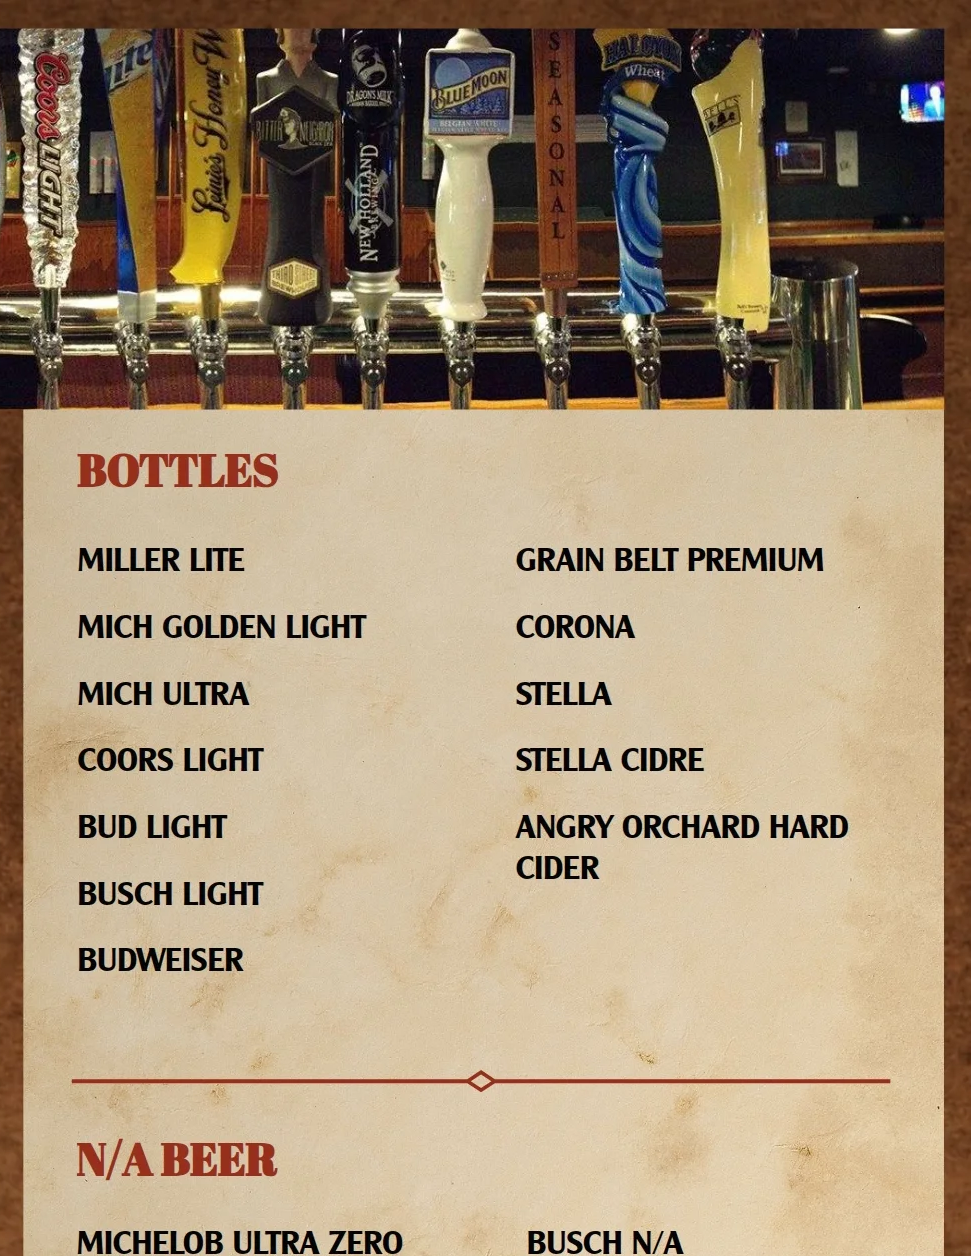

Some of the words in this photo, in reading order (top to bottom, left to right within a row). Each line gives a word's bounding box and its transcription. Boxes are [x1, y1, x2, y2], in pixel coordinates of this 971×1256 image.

[624, 63, 666, 82] Wheat
[34, 52, 70, 142] Coors
[431, 84, 470, 112] BLUE
[471, 69, 508, 96] MOON
[188, 66, 230, 151] Honey
[547, 31, 565, 240] SEASONAL
[37, 141, 64, 238] LIGHT
[359, 144, 379, 220] HOLLAND
[360, 225, 378, 261] NEW
[77, 453, 278, 487] BOTTLES
[78, 548, 180, 571] MILLER
[191, 548, 245, 571] LITE
[516, 548, 603, 571] GRAIN
[615, 548, 679, 571] BELT
[688, 548, 823, 571] PREMIUM
[516, 615, 635, 638] CORONA
[516, 682, 612, 705] STELLA
[516, 748, 612, 771] STELLA
[621, 748, 704, 771] CIDRE
[515, 815, 615, 838] ANGRY
[623, 815, 759, 838] ORCHARD
[770, 815, 848, 838] HARD
[516, 856, 599, 879] CIDER
[79, 948, 244, 971] BUDWEISER
[77, 1139, 154, 1180] N/A
[161, 1143, 278, 1176] BEER
[78, 1231, 223, 1254] MICHELOB
[234, 1231, 320, 1254] ULTRA
[329, 1231, 403, 1254] ZERO
[528, 1231, 621, 1254] BUSCH
[633, 1231, 684, 1254] N/A
